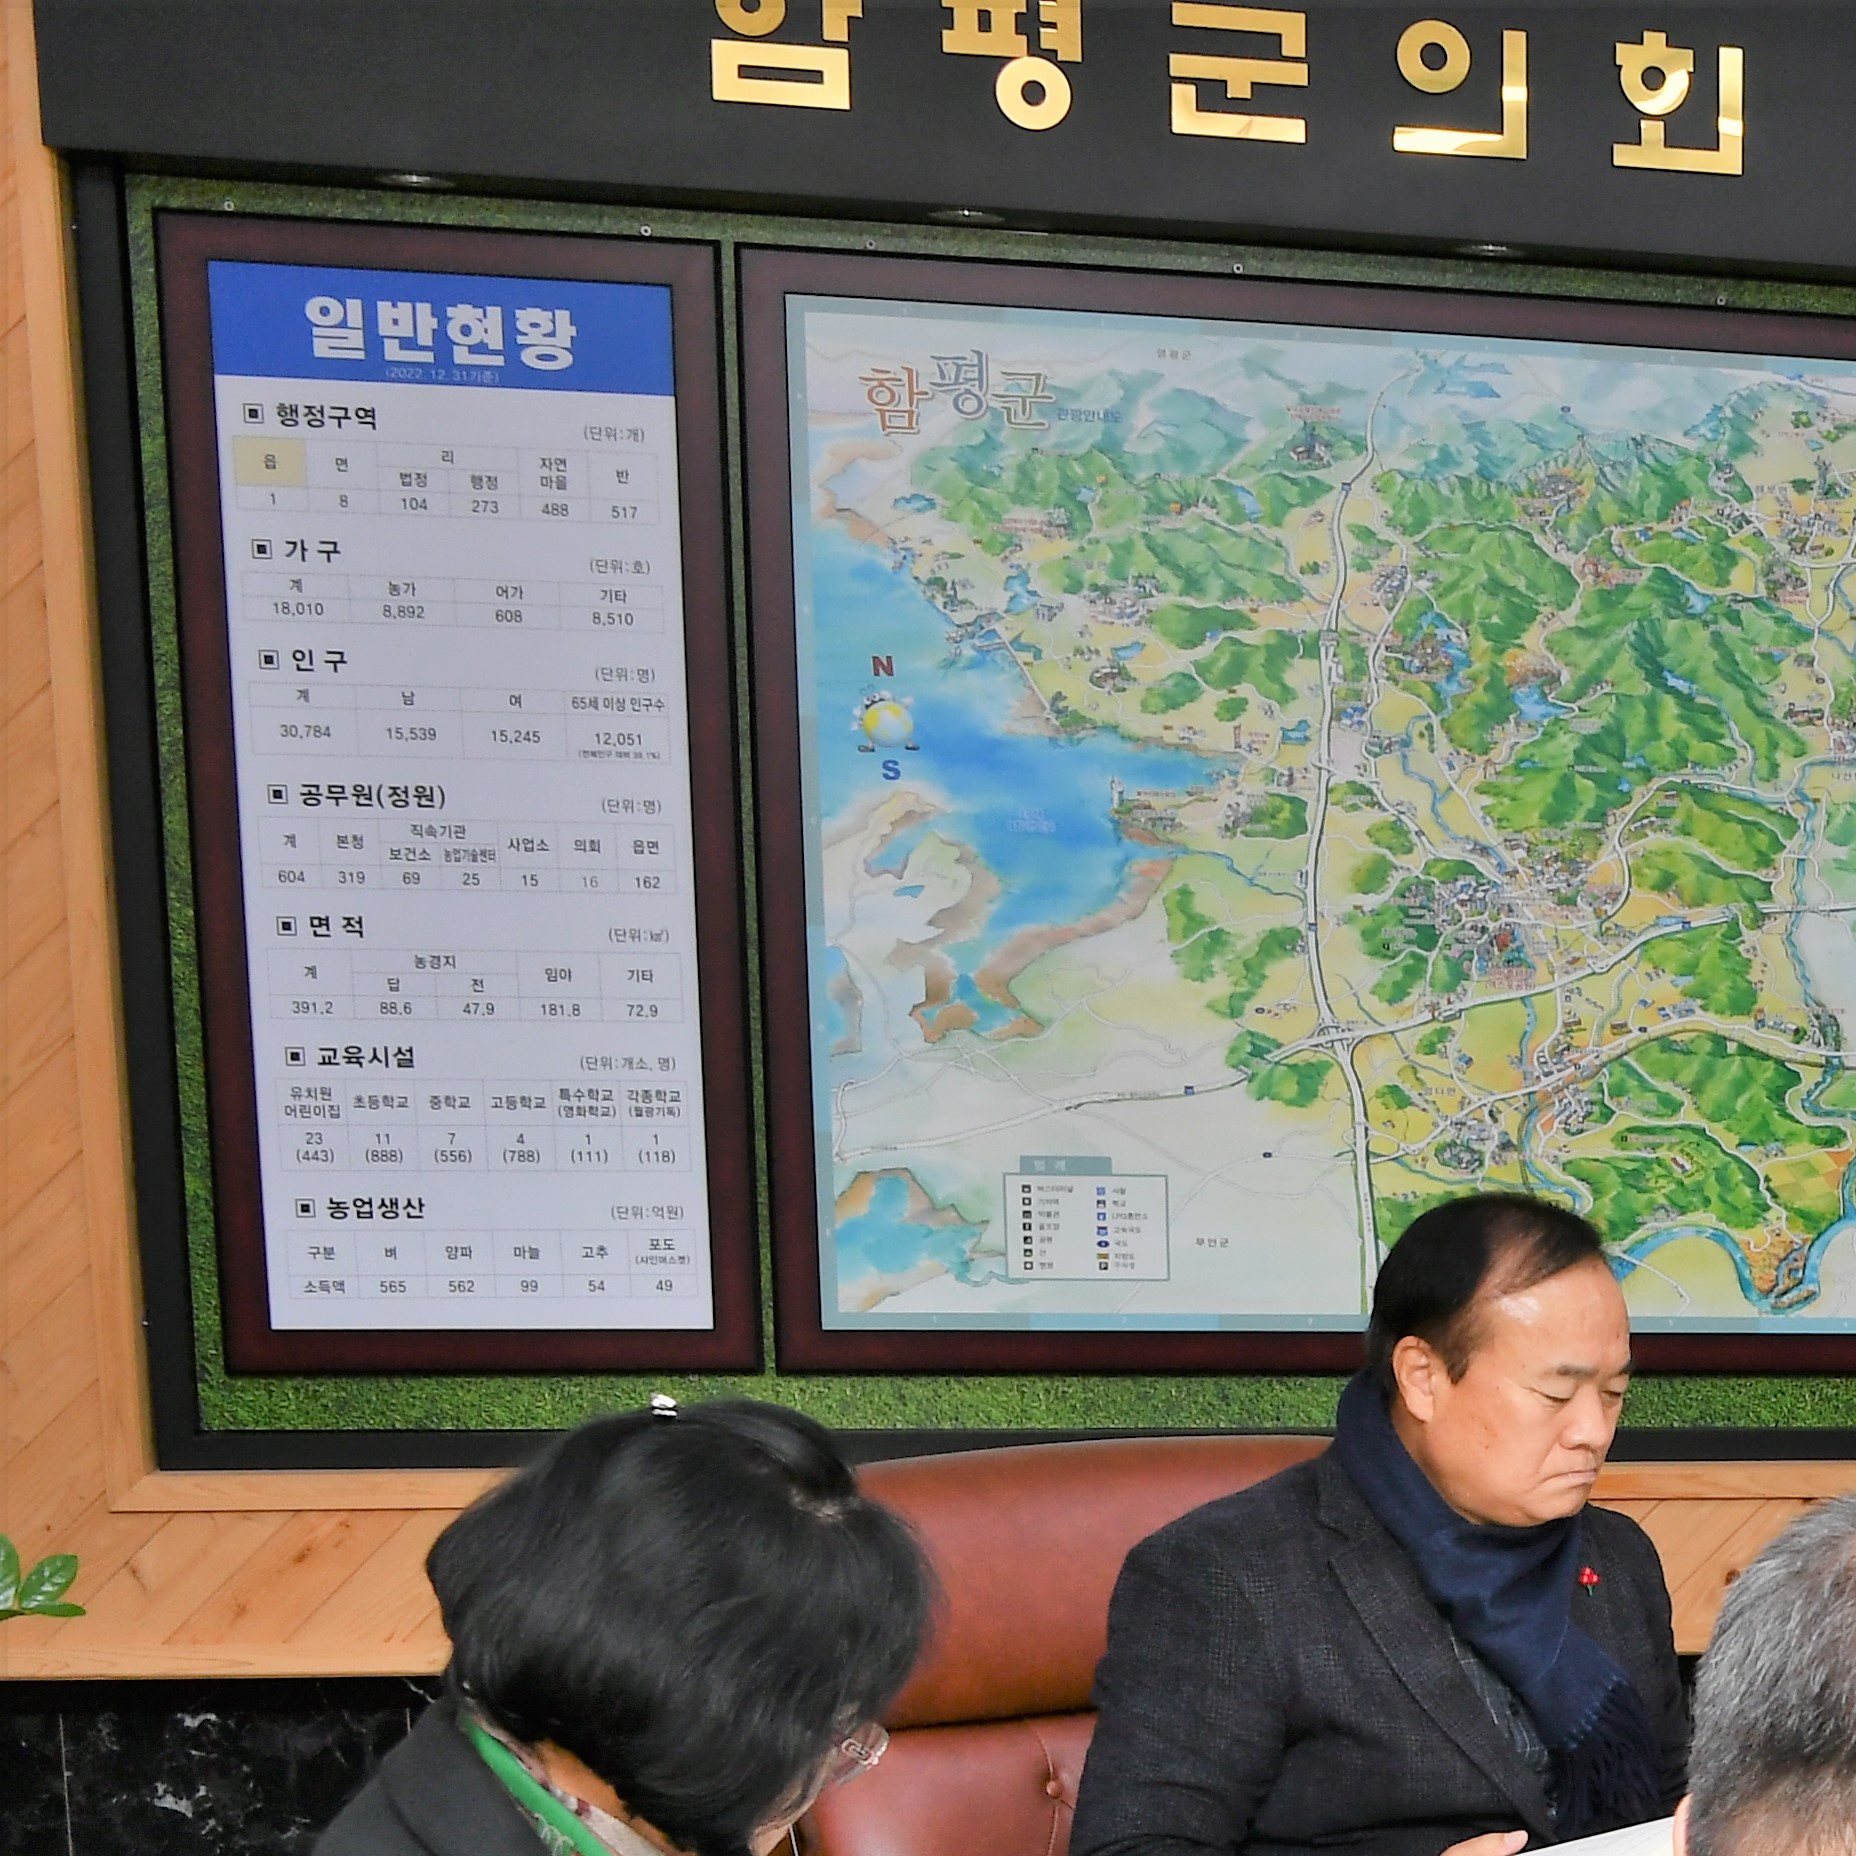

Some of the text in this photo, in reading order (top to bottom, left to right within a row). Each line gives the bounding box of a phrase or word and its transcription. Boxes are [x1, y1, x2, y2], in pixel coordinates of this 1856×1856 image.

[305, 295, 577, 371] 일반현황
[858, 349, 1056, 435] 함평군
[276, 402, 377, 431] 행정구역
[583, 425, 645, 443] (단위:개)
[441, 450, 630, 485] 리 반
[399, 472, 567, 491] 법정 행정 마을
[401, 497, 638, 519] 104 273 488 517
[589, 559, 651, 575] (단위:호)
[600, 588, 627, 604] 기타
[273, 601, 324, 617] 18,010
[495, 608, 523, 624] 608
[592, 611, 634, 627] 8,510
[594, 667, 656, 684] (단위:명)
[872, 656, 894, 676] N
[280, 724, 642, 747] 30,784 15,539 15,245 12,051
[881, 759, 901, 780] S
[299, 783, 446, 810] 공무원(정원)
[601, 798, 662, 815] (단위:명)
[410, 823, 467, 840] 직속기관
[507, 837, 550, 853] 사업소
[573, 839, 601, 854] 의회
[389, 847, 432, 862] 보건소
[278, 869, 661, 889] 604 319 69 25 15 162
[414, 954, 654, 984] 농경지 임야 기타
[292, 1000, 659, 1018] 391.2 88.6 47.9 181.8 72.9
[317, 1045, 415, 1069] 교육시설
[353, 1087, 682, 1111] 초등학교 중학교 고등학교 특수학교 각종학교
[327, 1197, 425, 1220] 농업생산
[610, 1205, 684, 1221] (단위:억원)
[307, 1246, 335, 1261] 구분
[581, 1244, 609, 1260] 고추
[648, 1238, 676, 1251] 포도
[379, 1280, 407, 1294] 565
[448, 1279, 475, 1293] 562
